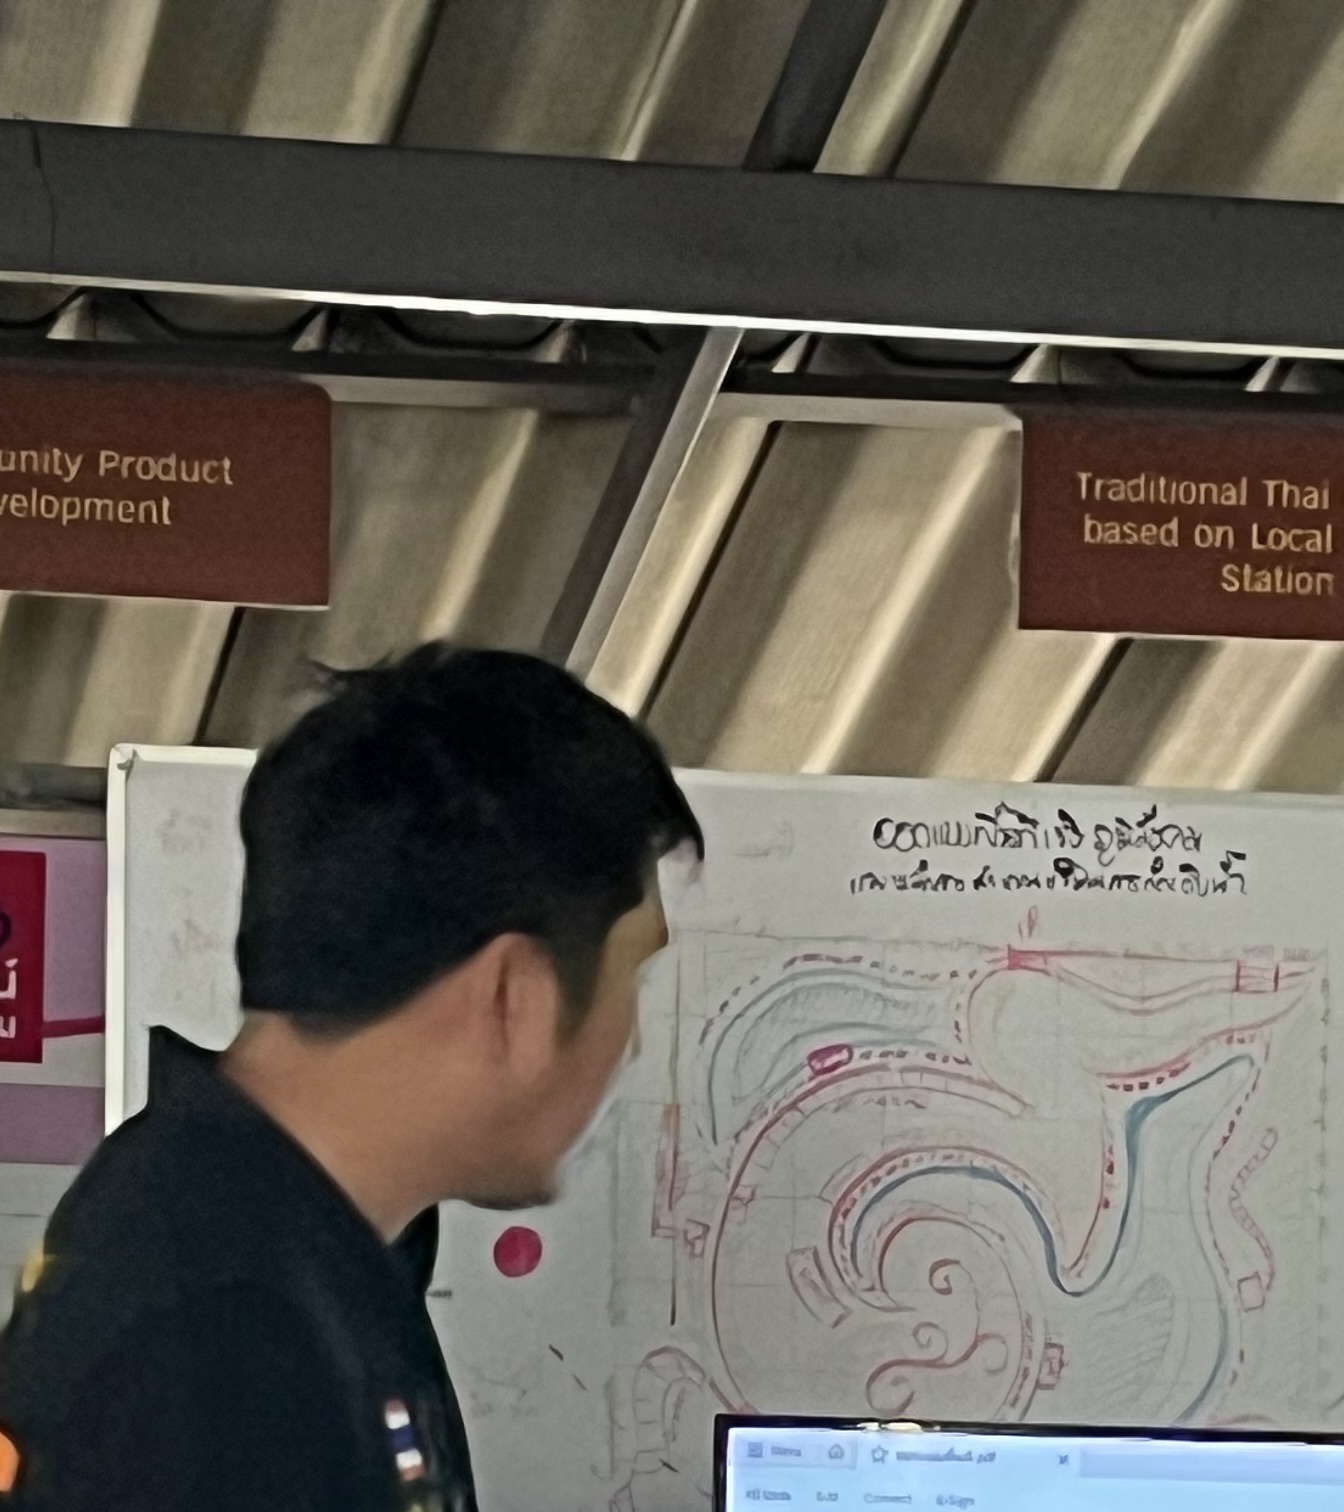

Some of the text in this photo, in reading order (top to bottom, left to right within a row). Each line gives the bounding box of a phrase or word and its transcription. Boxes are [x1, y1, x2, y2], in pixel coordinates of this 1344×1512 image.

[98, 450, 234, 487] Product
[1076, 471, 1247, 508] Traditional
[1262, 479, 1330, 512] Thai
[1084, 514, 1179, 549] based
[1194, 523, 1235, 550] on
[1251, 522, 1332, 555] Local
[1220, 563, 1335, 597] Station
